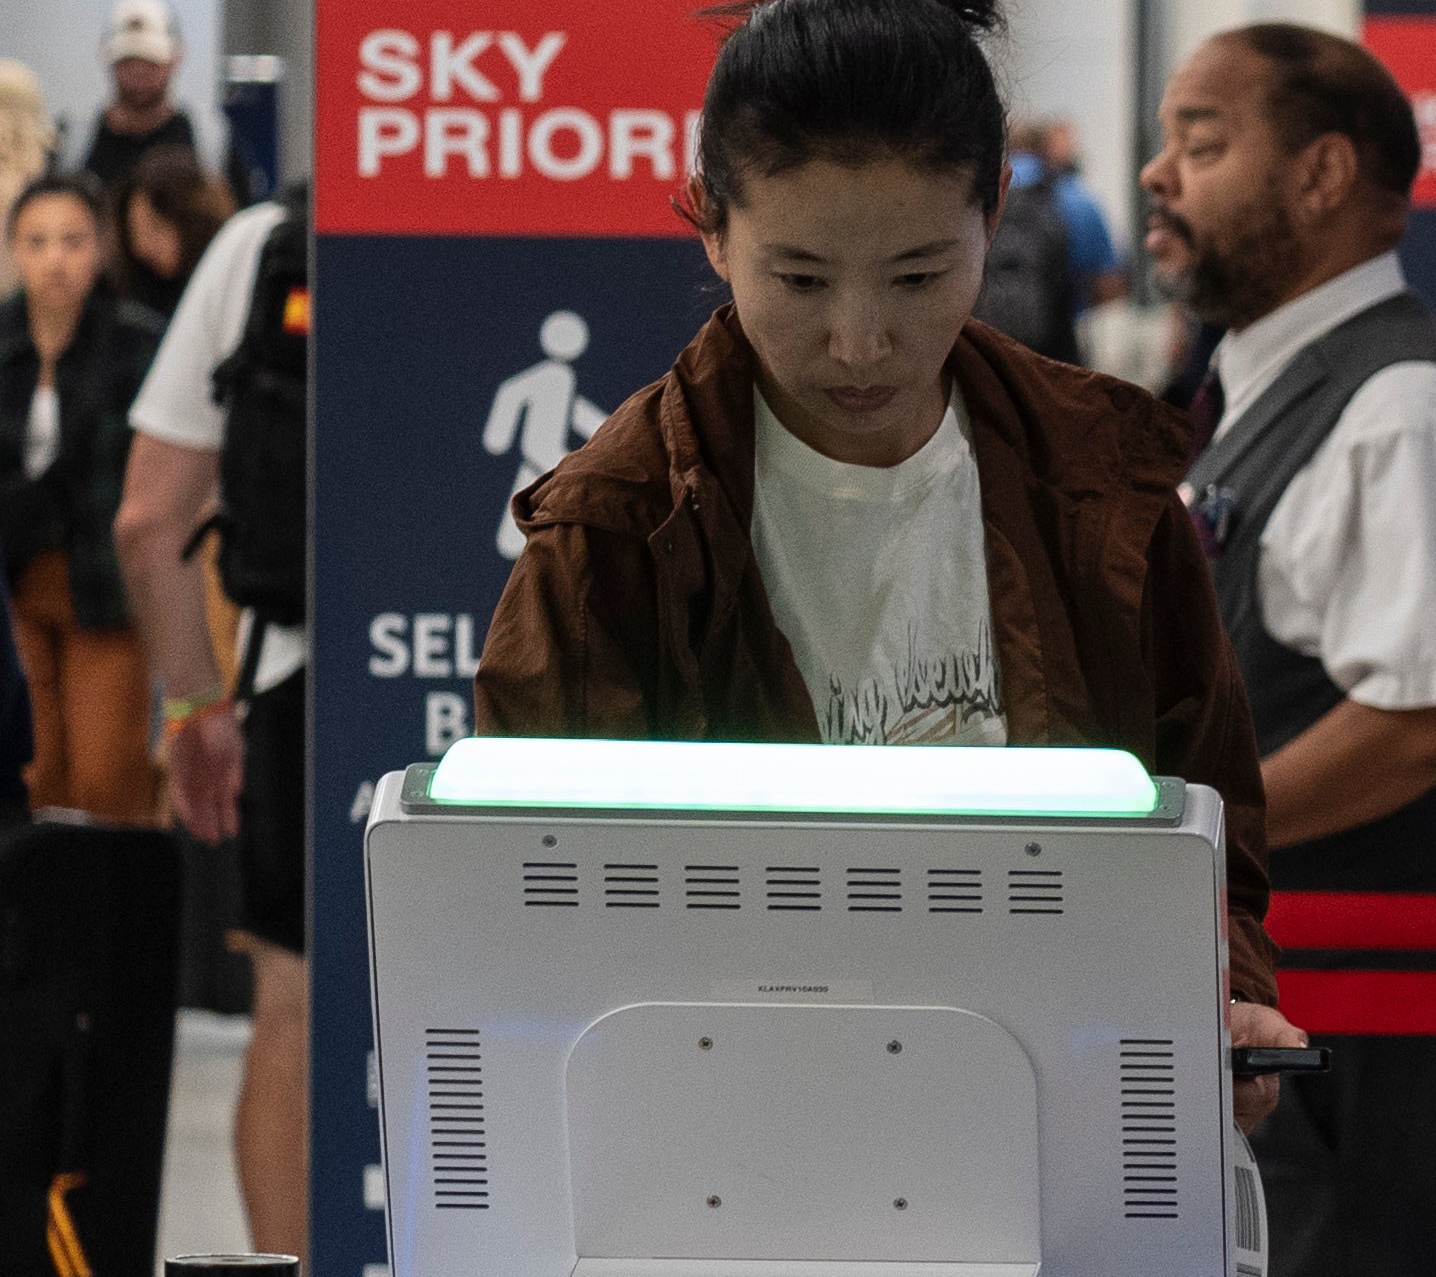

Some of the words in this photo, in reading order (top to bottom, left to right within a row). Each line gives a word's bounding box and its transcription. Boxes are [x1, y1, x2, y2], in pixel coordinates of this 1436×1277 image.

[356, 29, 566, 101] SKY
[356, 109, 703, 180] PRIORI
[368, 612, 481, 678] SEL
